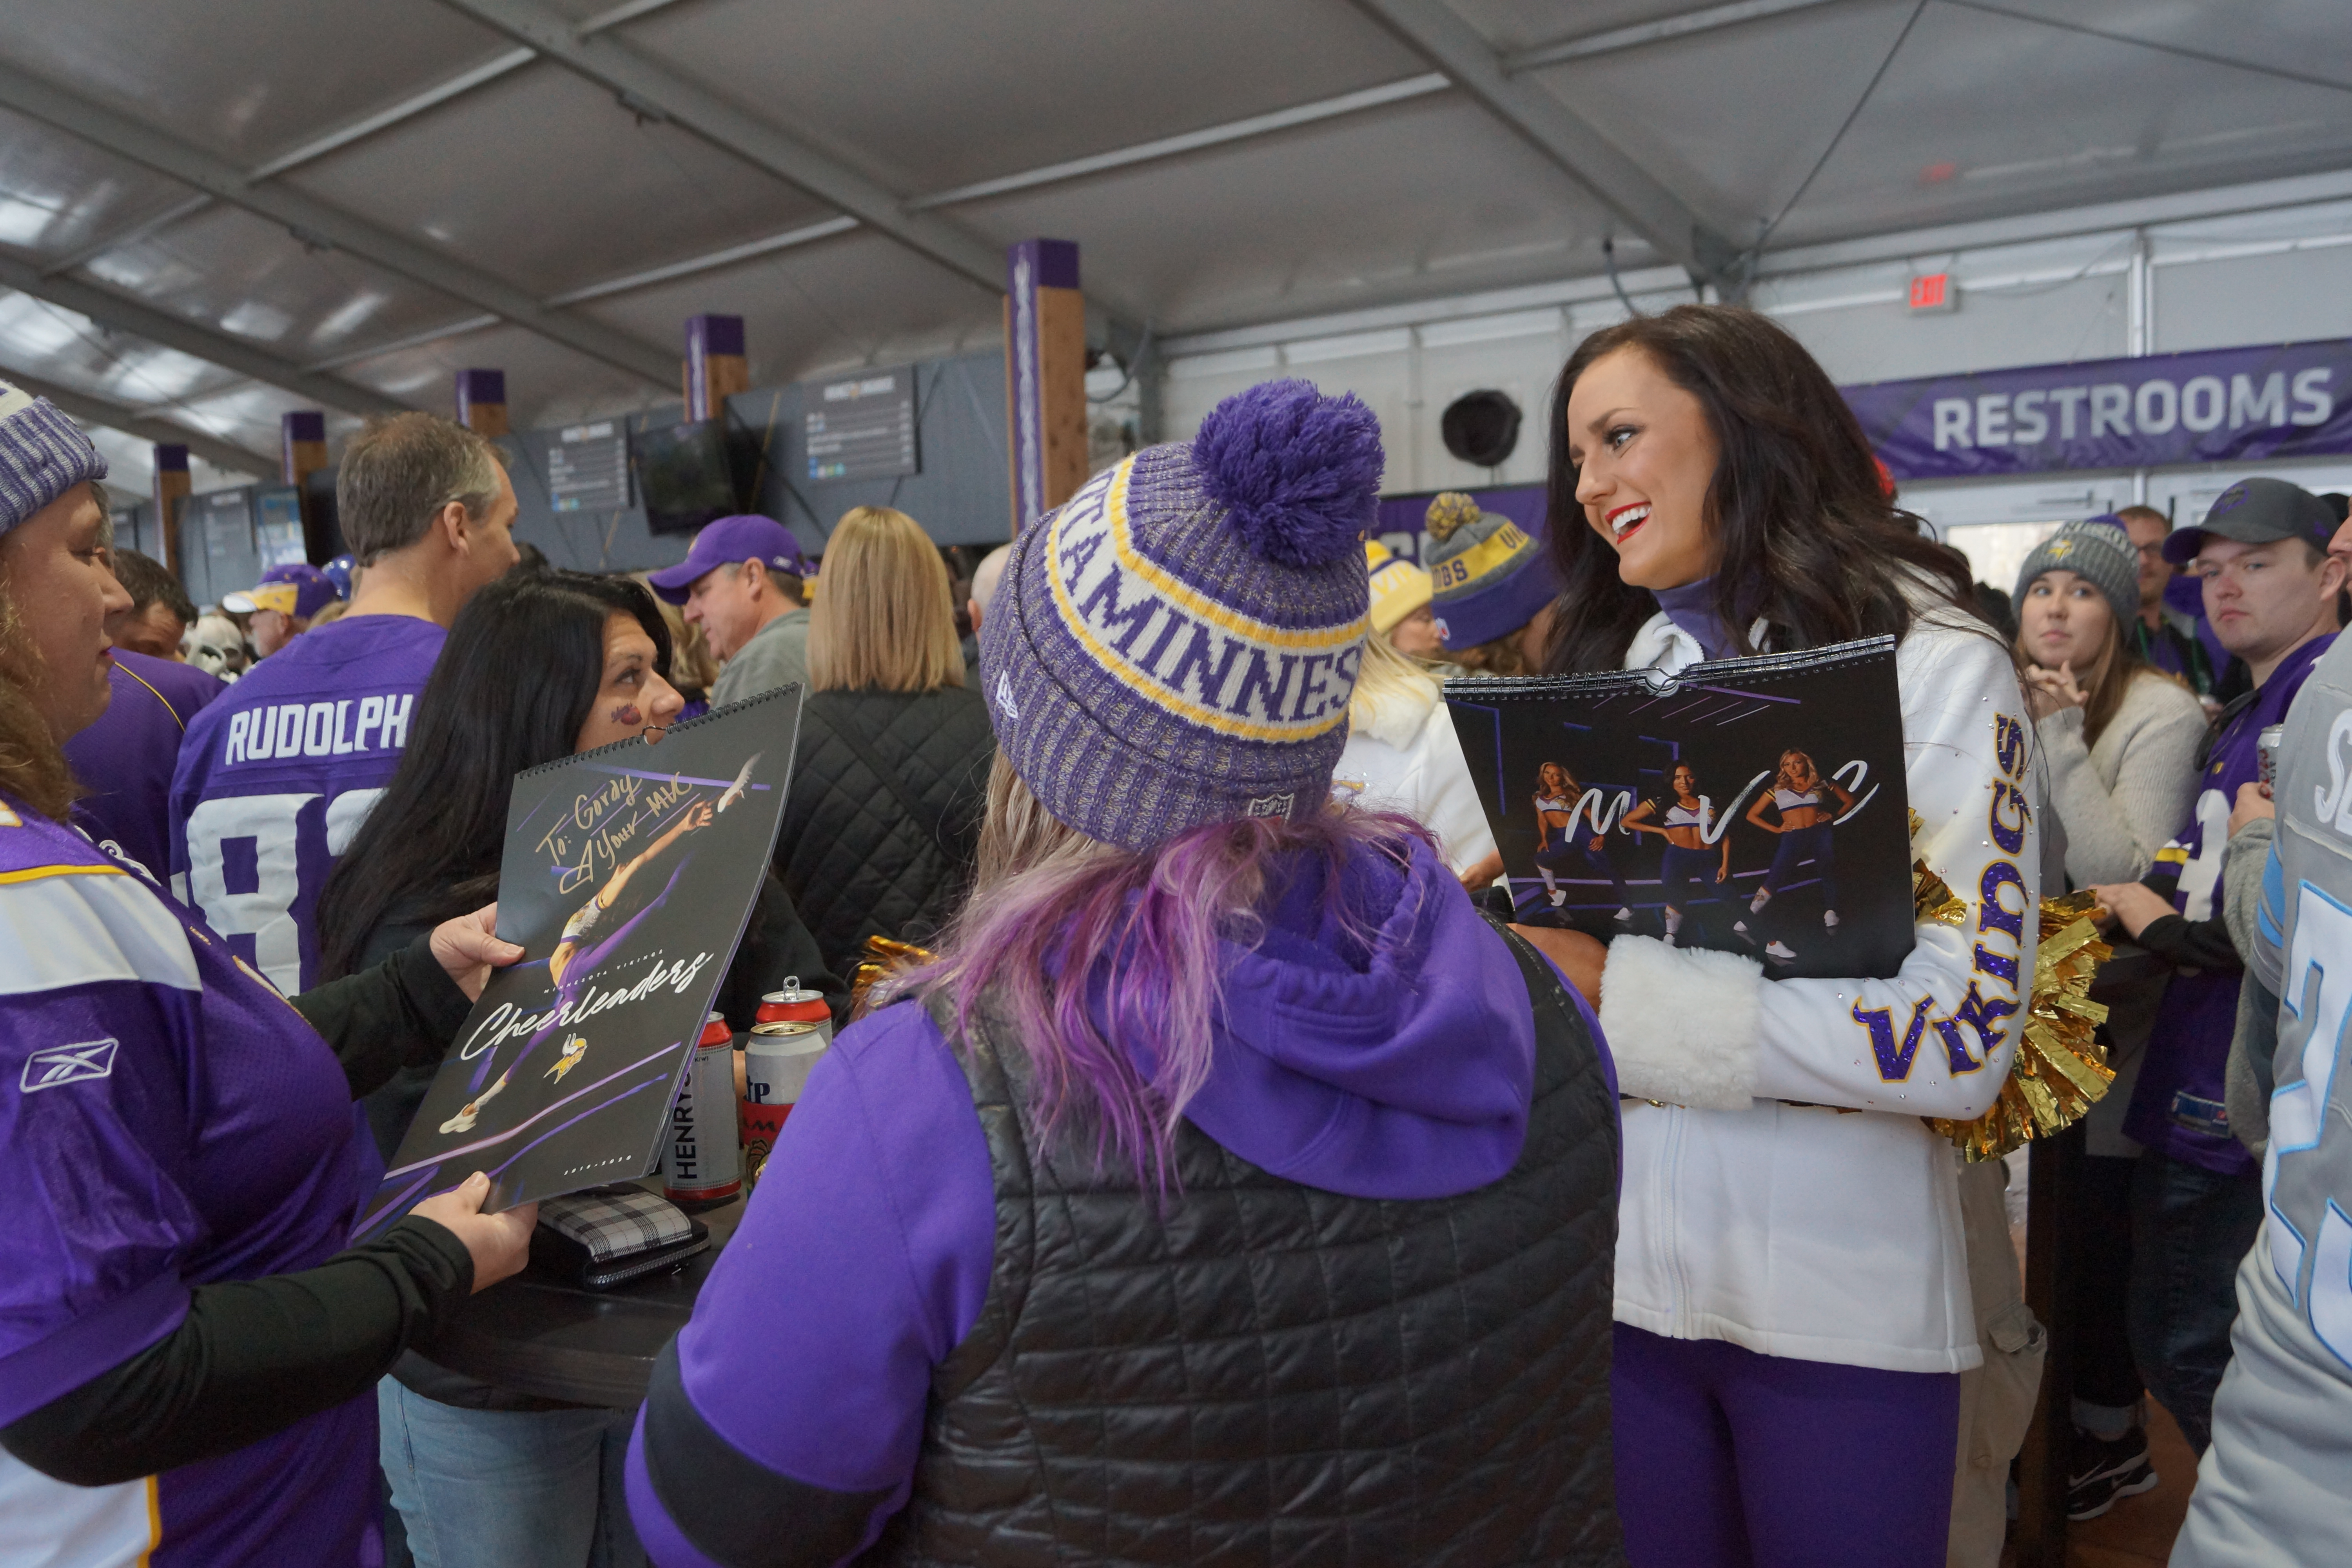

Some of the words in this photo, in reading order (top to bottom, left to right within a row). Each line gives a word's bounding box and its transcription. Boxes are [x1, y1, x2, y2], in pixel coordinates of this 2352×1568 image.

[1910, 274, 1947, 308] EXIT
[1933, 367, 2334, 452] RESTROOMS
[225, 694, 413, 765] RUDOLPH
[535, 813, 572, 866] To:
[575, 774, 642, 830] Gordy
[1851, 711, 2033, 1083] VIKINGS
[461, 952, 715, 1060] Cheerleaders
[543, 970, 607, 994] MINNESOTA
[617, 949, 663, 970] VIKINGS
